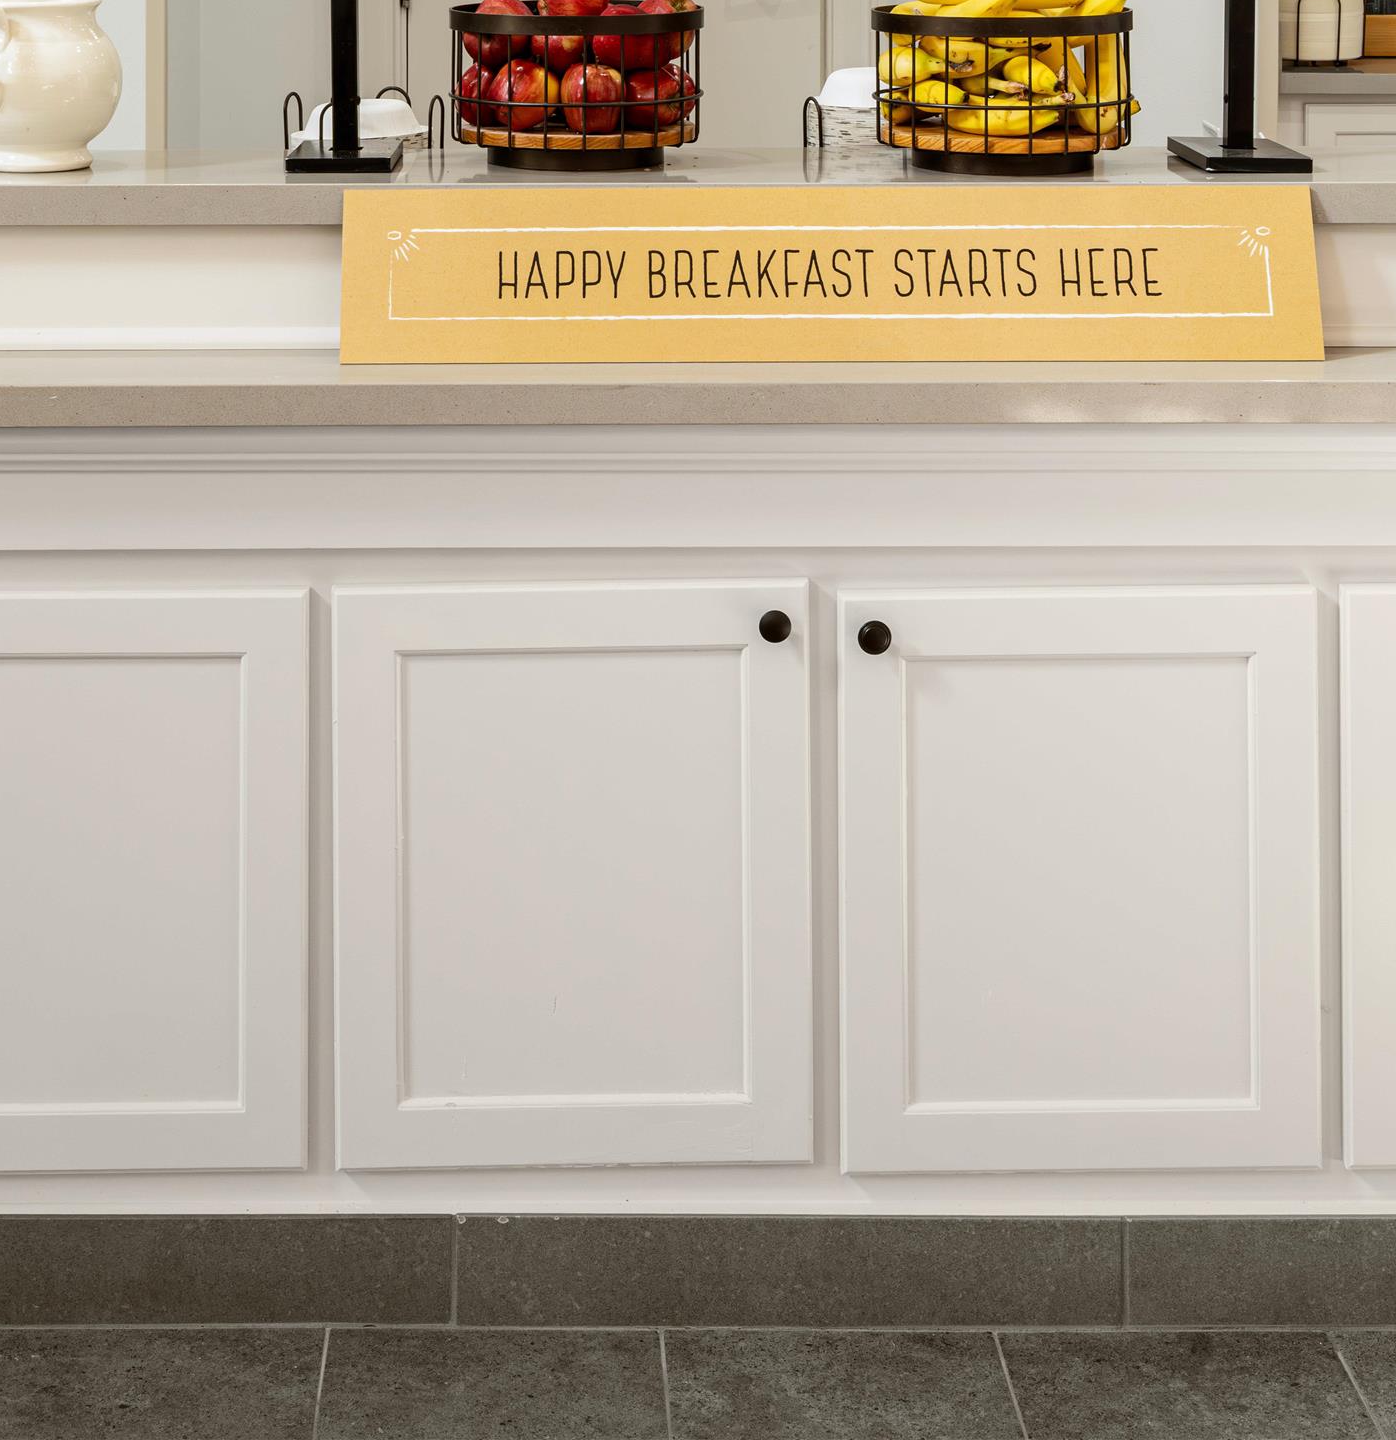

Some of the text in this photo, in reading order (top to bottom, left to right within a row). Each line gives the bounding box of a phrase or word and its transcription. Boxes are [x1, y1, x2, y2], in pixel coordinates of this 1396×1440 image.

[497, 246, 1163, 301] HAPPY BREAKFAST STARTS HERE
